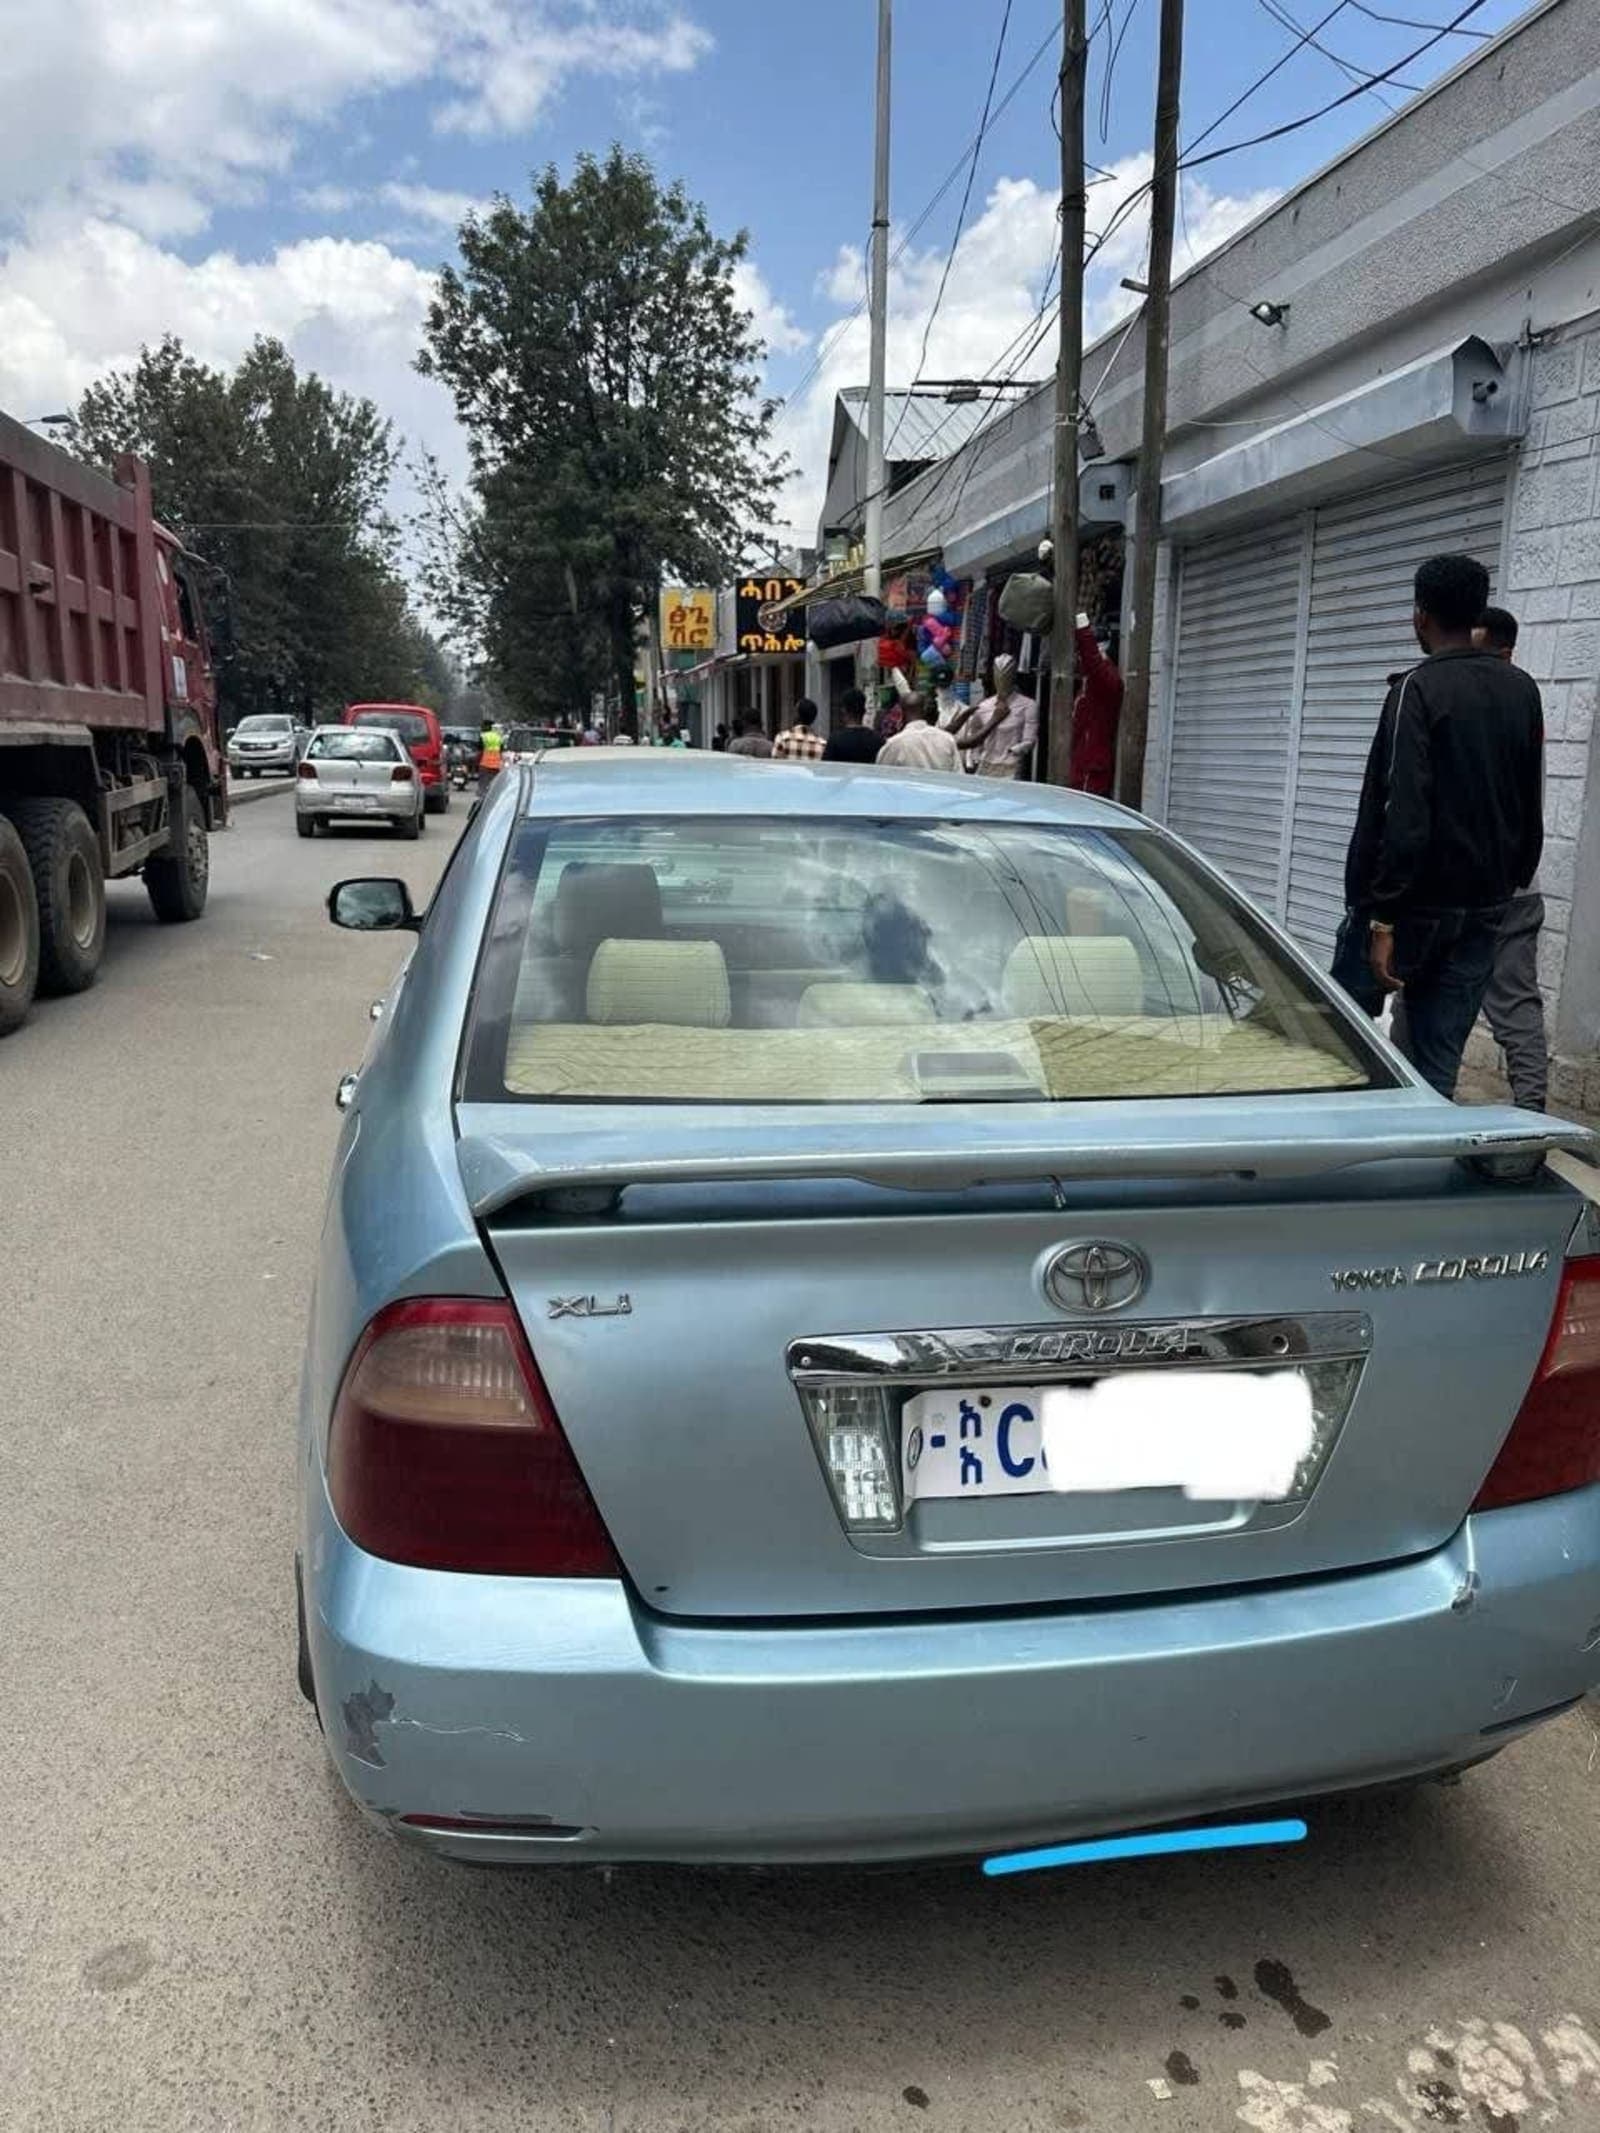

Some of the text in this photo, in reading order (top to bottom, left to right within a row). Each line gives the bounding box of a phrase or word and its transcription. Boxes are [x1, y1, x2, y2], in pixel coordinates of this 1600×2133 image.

[1330, 1250, 1549, 1292] TOYOTA COROLLA
[1004, 1328, 1189, 1361] COROLLA
